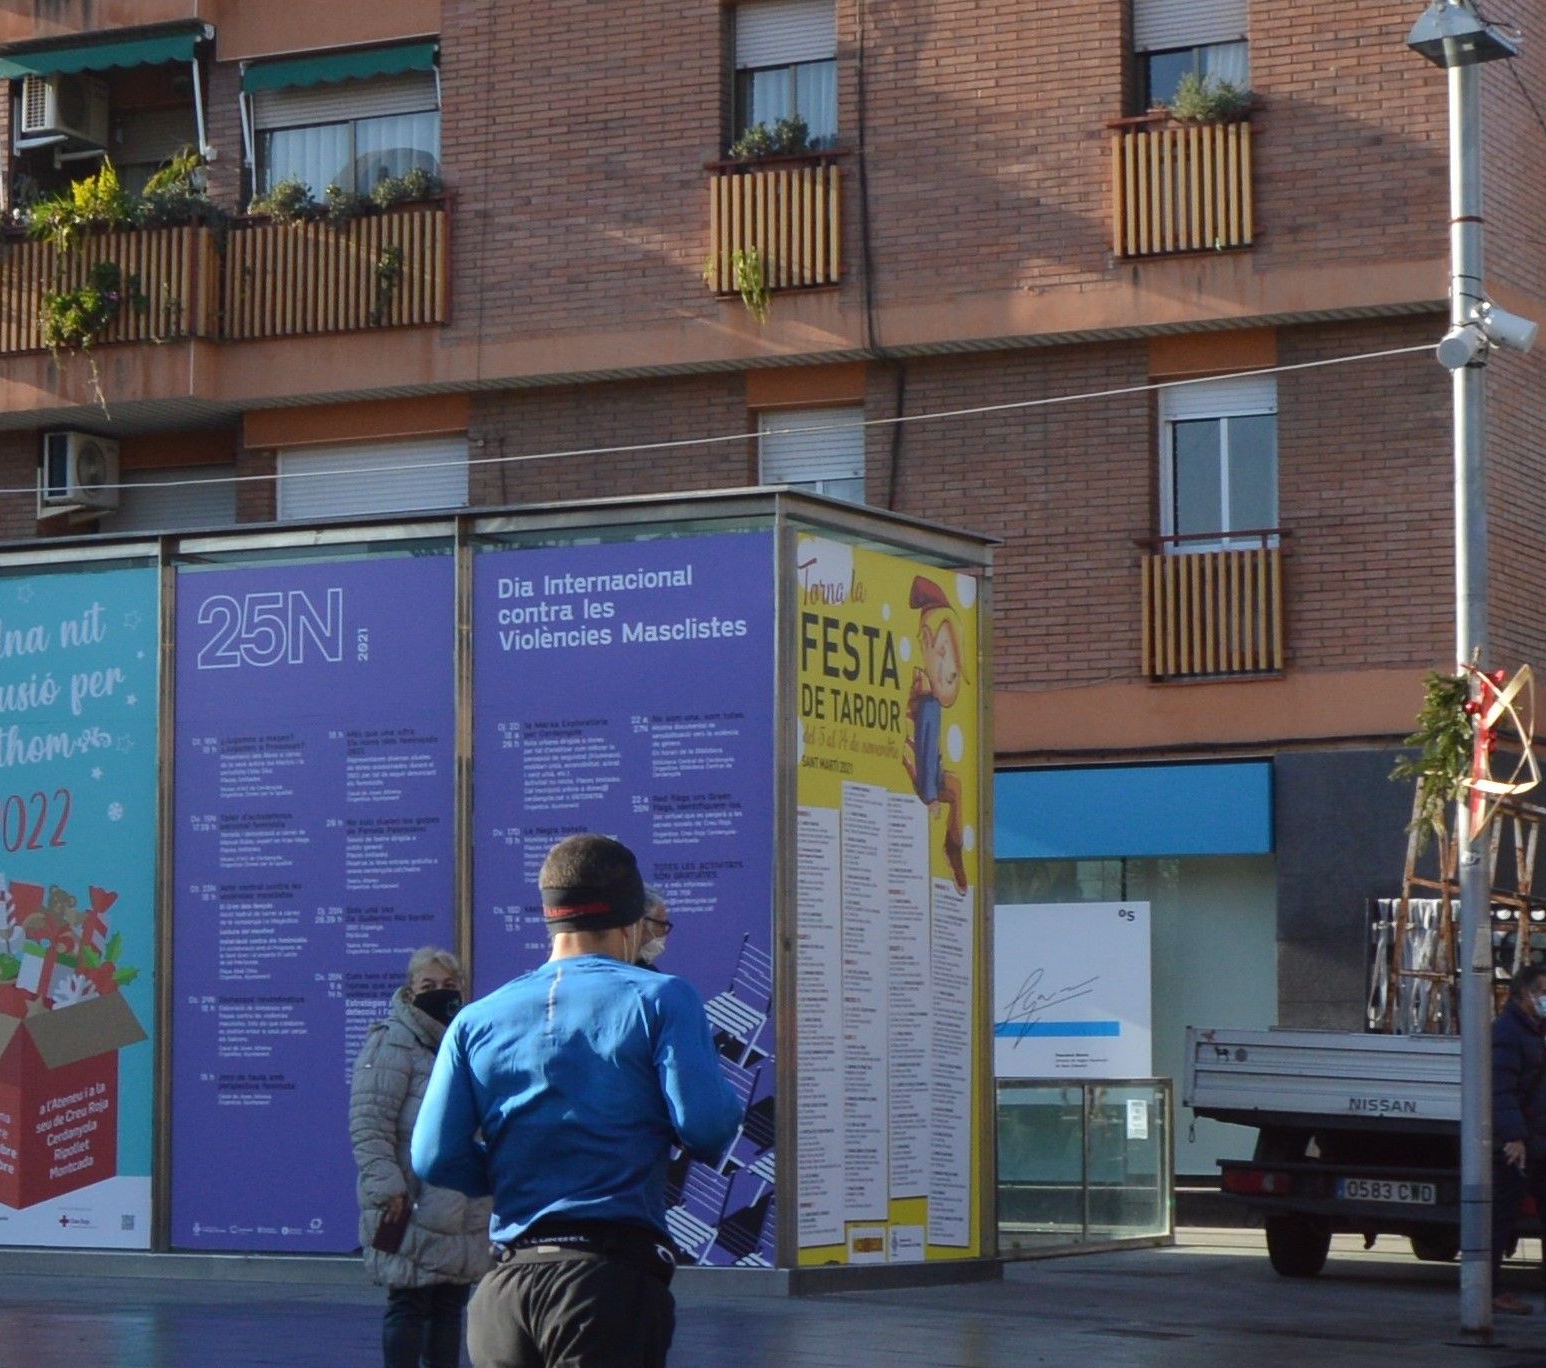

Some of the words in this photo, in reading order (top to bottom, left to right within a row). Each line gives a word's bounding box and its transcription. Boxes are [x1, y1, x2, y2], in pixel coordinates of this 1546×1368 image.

[498, 577, 534, 599] Dia
[544, 564, 692, 596] Internacional
[798, 558, 845, 605] Torna
[851, 569, 867, 603] la
[60, 602, 106, 648] nit
[197, 588, 342, 669] 25N
[498, 601, 574, 625] contra
[584, 598, 615, 619] les
[357, 628, 369, 662] 2021
[499, 625, 612, 652] Violències
[622, 616, 747, 643] Masclistes
[802, 611, 900, 691] FESTA
[70, 667, 125, 716] per
[802, 683, 825, 720] DE
[831, 688, 901, 734] TARDOR
[802, 755, 819, 769] SANT
[840, 760, 853, 774] 2021
[39, 1106, 45, 1115] a
[96, 1082, 105, 1095] la
[1349, 1098, 1417, 1114] NISSAN
[35, 1122, 51, 1134] seu
[53, 1115, 65, 1128] de
[66, 1107, 87, 1122] Creu
[88, 1099, 109, 1115] Roja
[47, 1120, 97, 1146] Cerdanyola
[54, 1139, 90, 1160] Ripollet
[49, 1156, 94, 1180] Montcada
[1347, 1181, 1392, 1200] 0583
